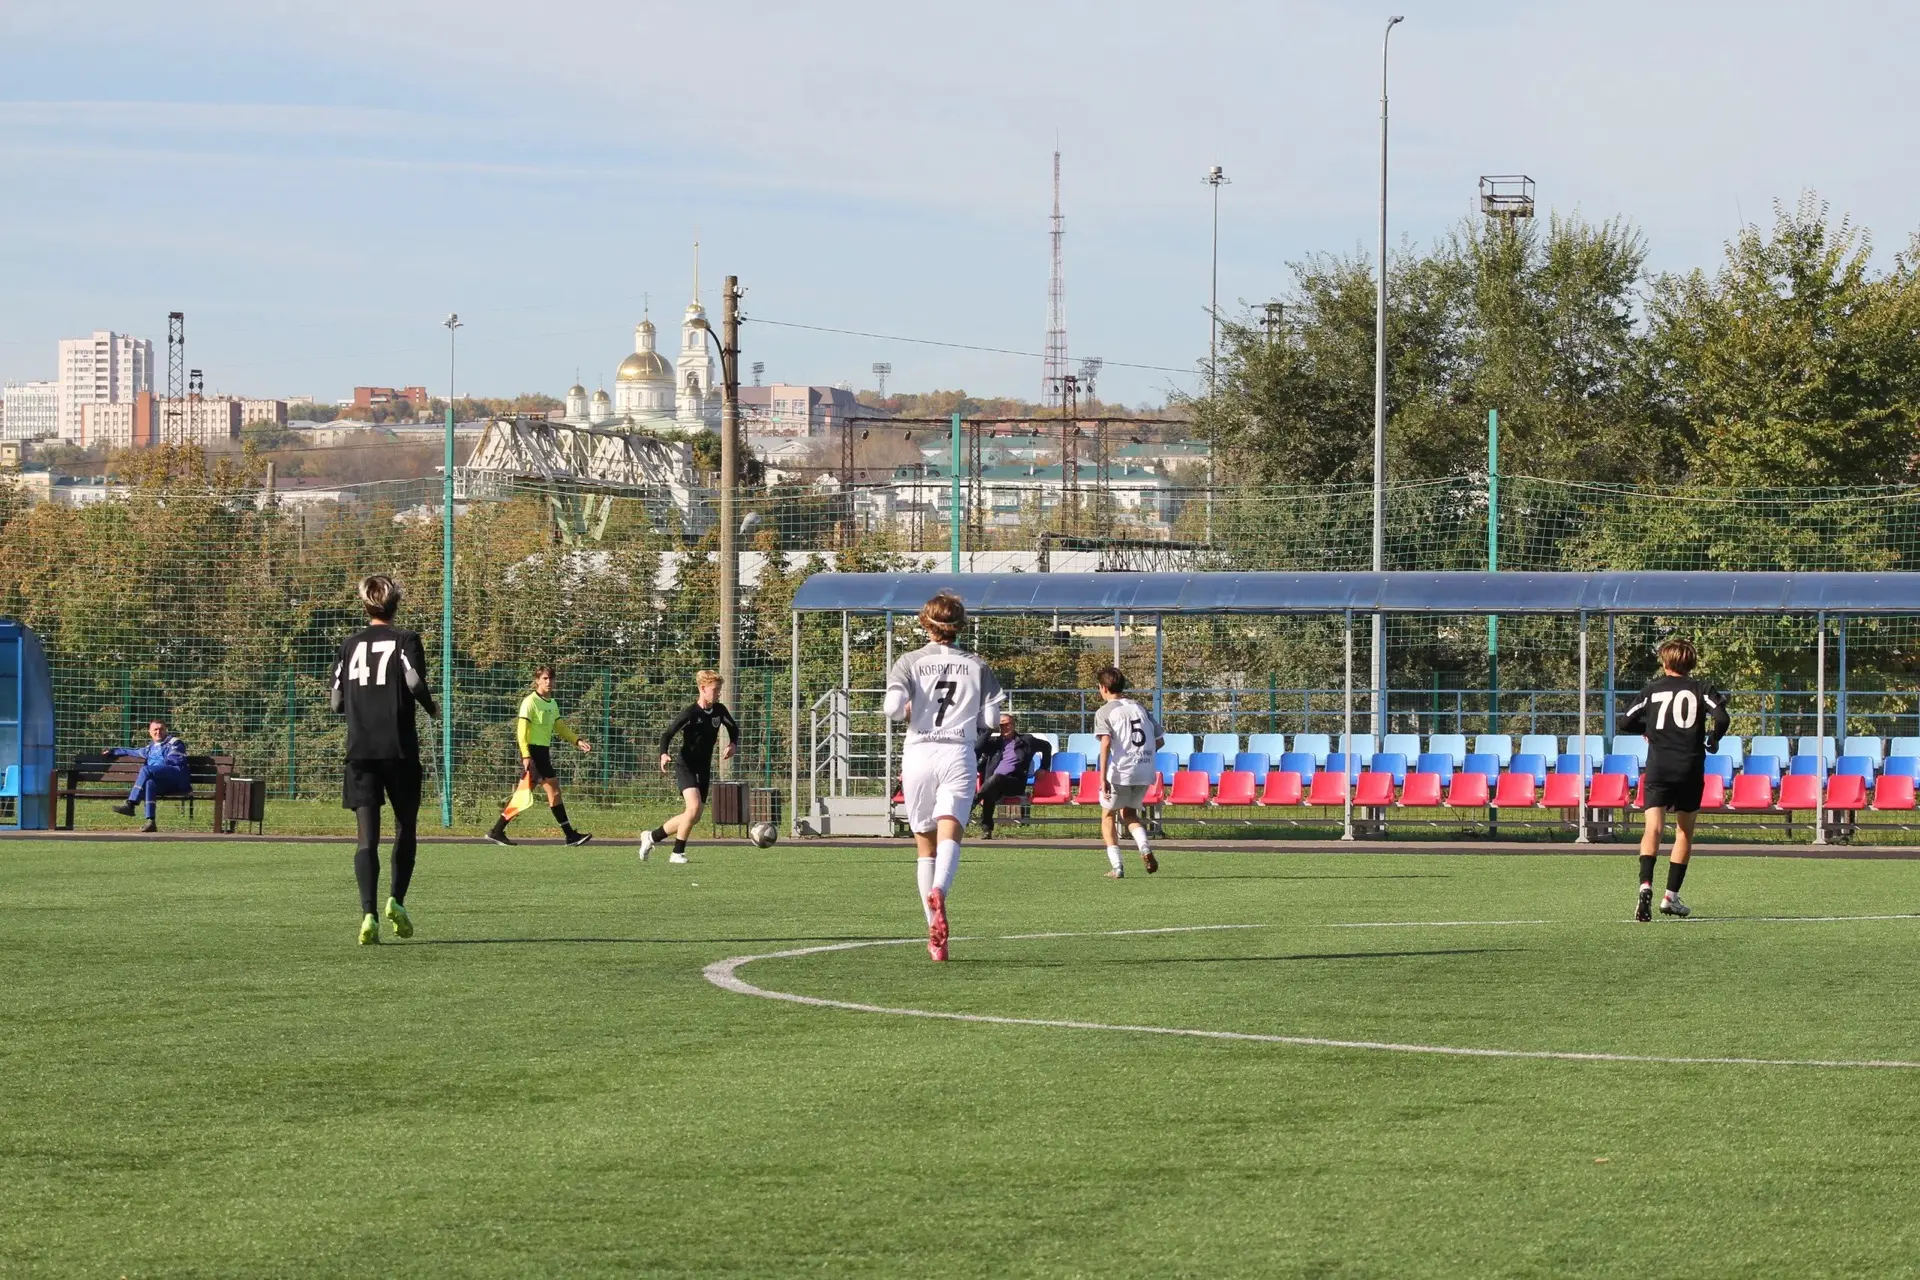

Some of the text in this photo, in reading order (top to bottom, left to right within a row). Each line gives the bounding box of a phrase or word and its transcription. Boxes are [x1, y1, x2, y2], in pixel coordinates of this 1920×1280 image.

[348, 640, 396, 686] 47
[919, 663, 969, 676] КОВРИГИН
[935, 681, 957, 727] 7
[1651, 689, 1697, 730] 70
[1130, 718, 1147, 747] 5
